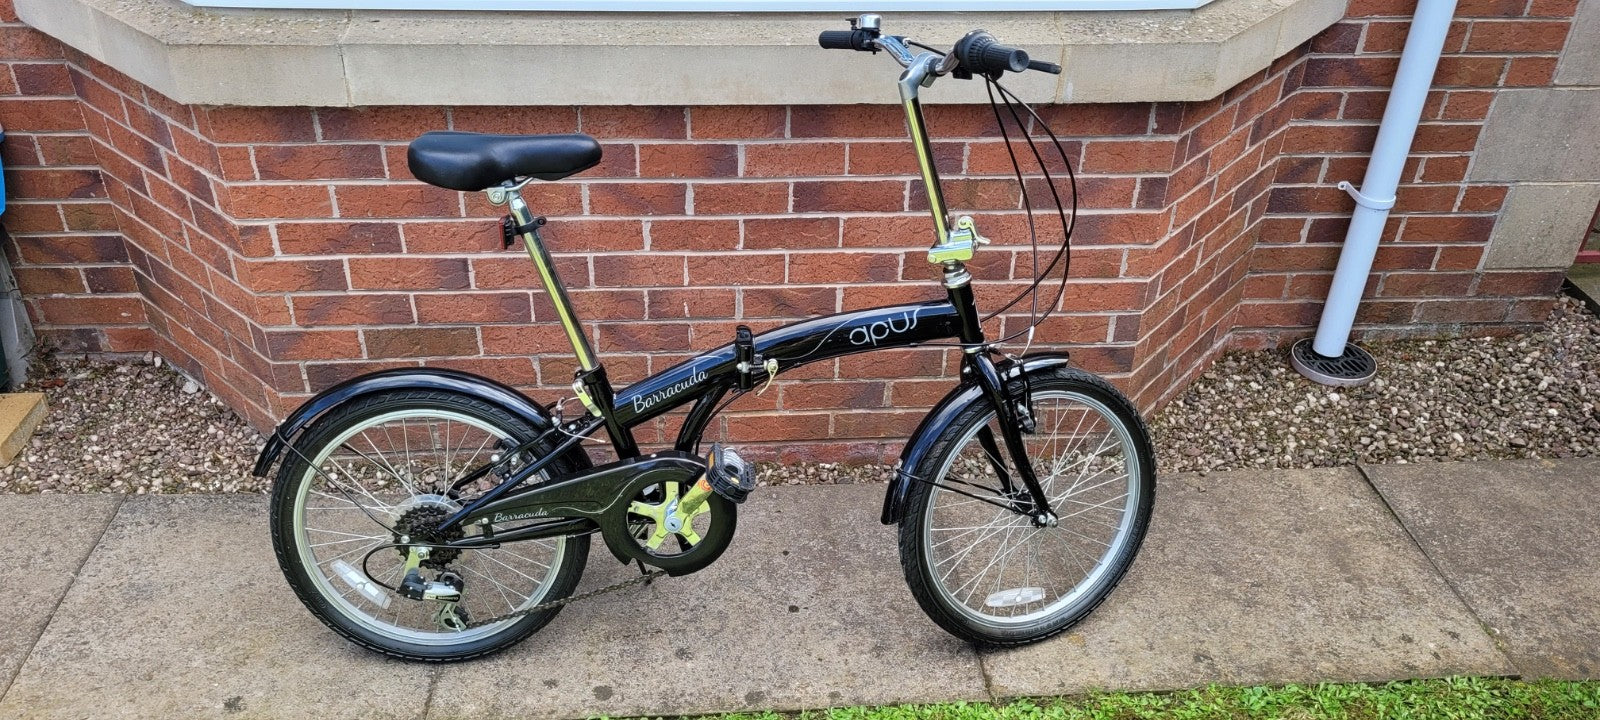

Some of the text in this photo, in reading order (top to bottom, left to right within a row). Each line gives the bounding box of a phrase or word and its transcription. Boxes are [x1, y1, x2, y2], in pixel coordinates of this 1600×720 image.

[849, 307, 920, 346] apus
[631, 366, 709, 413] Barracuda
[494, 507, 549, 522] Barracuda
